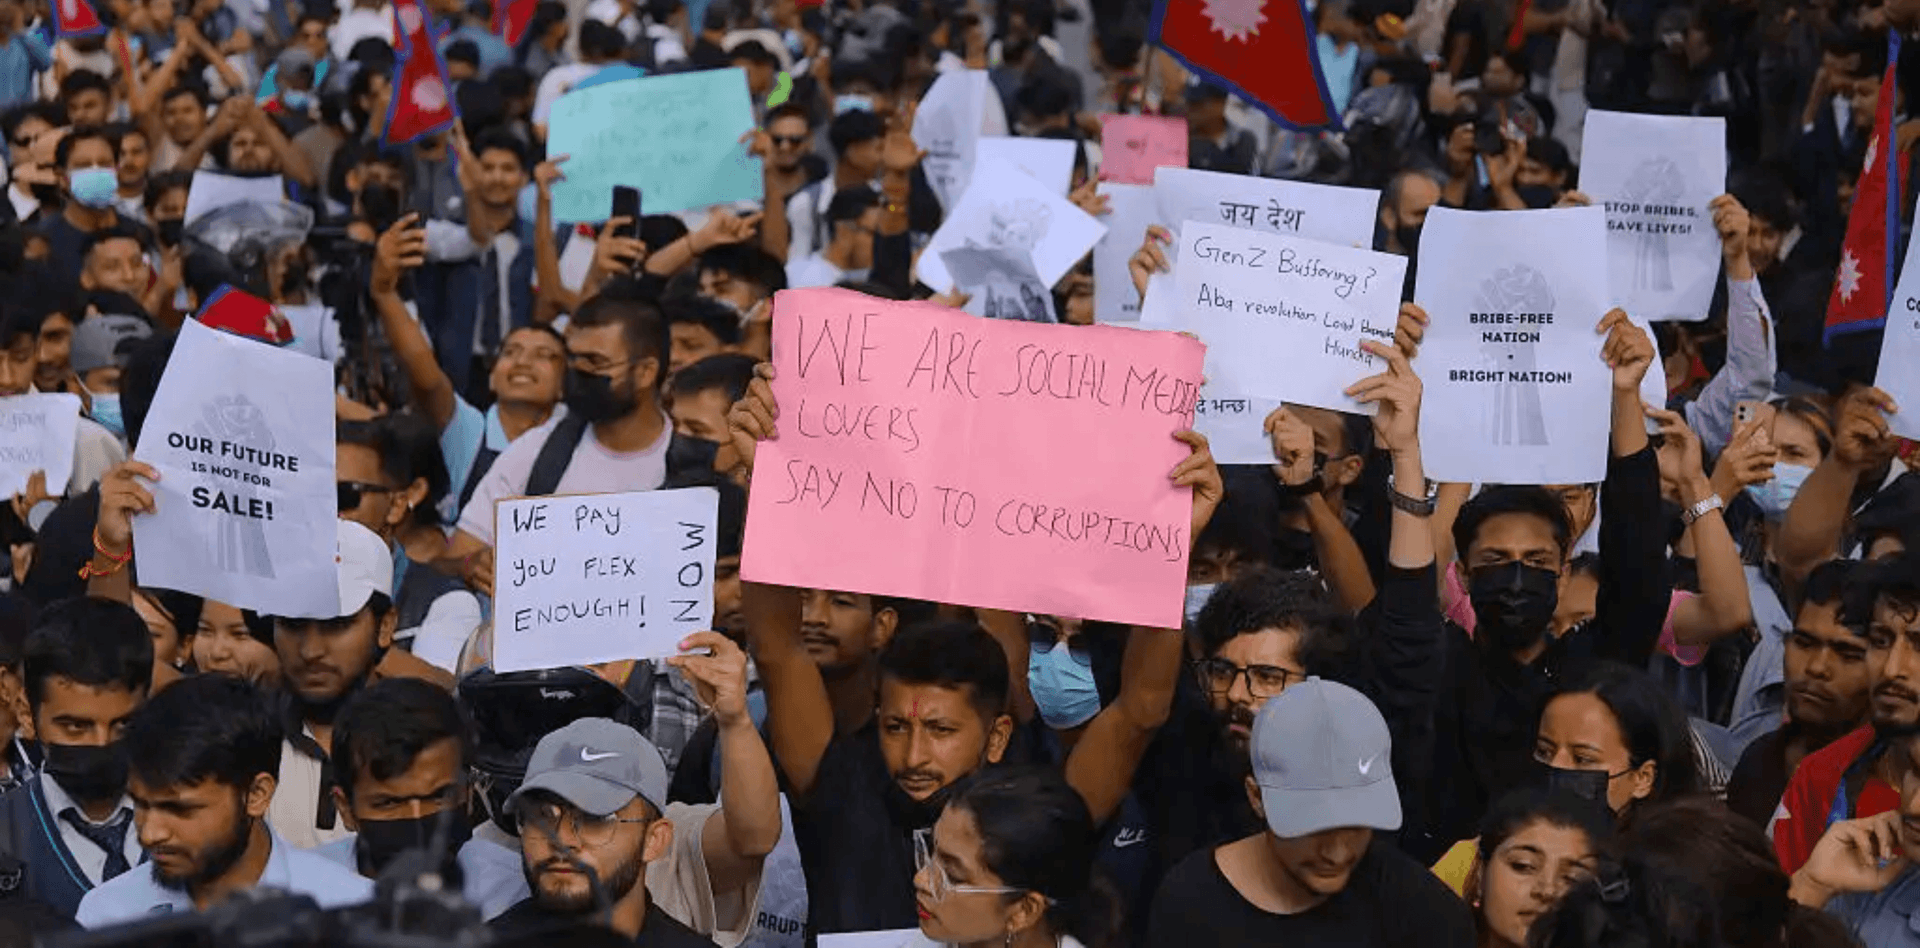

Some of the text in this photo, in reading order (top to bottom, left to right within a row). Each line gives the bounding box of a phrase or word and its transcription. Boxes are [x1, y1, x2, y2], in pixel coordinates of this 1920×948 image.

[1219, 199, 1306, 231] जय देश
[1605, 202, 1639, 213] STOP
[1607, 220, 1692, 235] SAVE LIVES!
[1198, 283, 1233, 312] Aba
[1244, 301, 1317, 321] revolution
[1469, 313, 1553, 324] BRIBE-FREE
[1482, 332, 1540, 343] NATION
[798, 314, 1199, 428] WE ARE SOCIAL MEDIA
[1449, 369, 1572, 384] BRIGHT NATION!
[798, 399, 920, 453] LOVERS
[167, 432, 299, 472] OUR FUTURE
[191, 462, 271, 487] IS NOT FOR
[192, 486, 274, 521] SALE!
[513, 504, 548, 532] WE
[776, 459, 1182, 562] SAY NO TO CORRUPTIONS
[584, 556, 636, 579] FLEX
[514, 595, 646, 632] ENOUGH!
